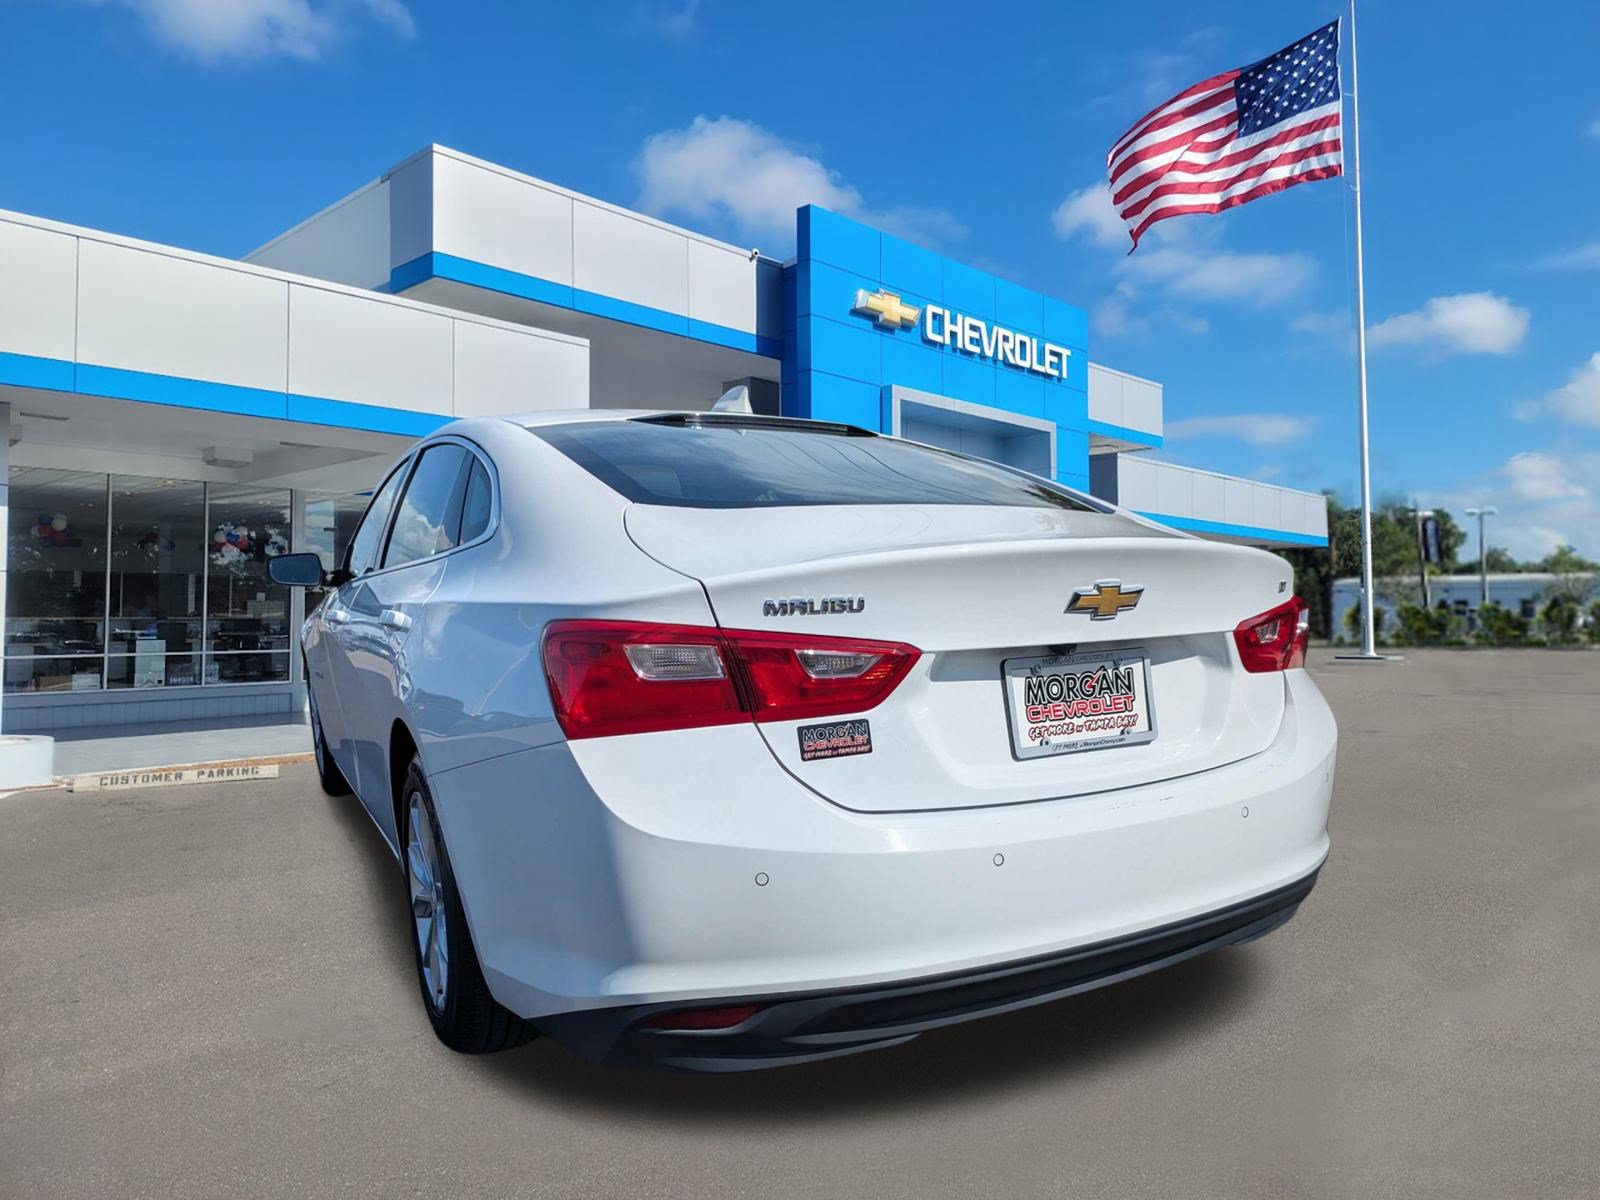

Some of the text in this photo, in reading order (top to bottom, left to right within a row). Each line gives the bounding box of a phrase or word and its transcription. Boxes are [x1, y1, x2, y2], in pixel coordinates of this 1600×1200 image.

[925, 304, 1072, 379] CHEVROLET
[763, 597, 865, 617] MALIBU
[1025, 666, 1134, 706] MORGAN
[1026, 695, 1135, 723] CHEVROLET
[802, 722, 869, 742] MORGAN
[1028, 727, 1047, 741] GET
[1047, 722, 1074, 736] MORE
[1084, 717, 1115, 731] TAMPA
[1116, 713, 1139, 729] BAY!
[803, 735, 869, 751] CHEVROLET
[99, 766, 260, 787] CUSTOMER PARKING
